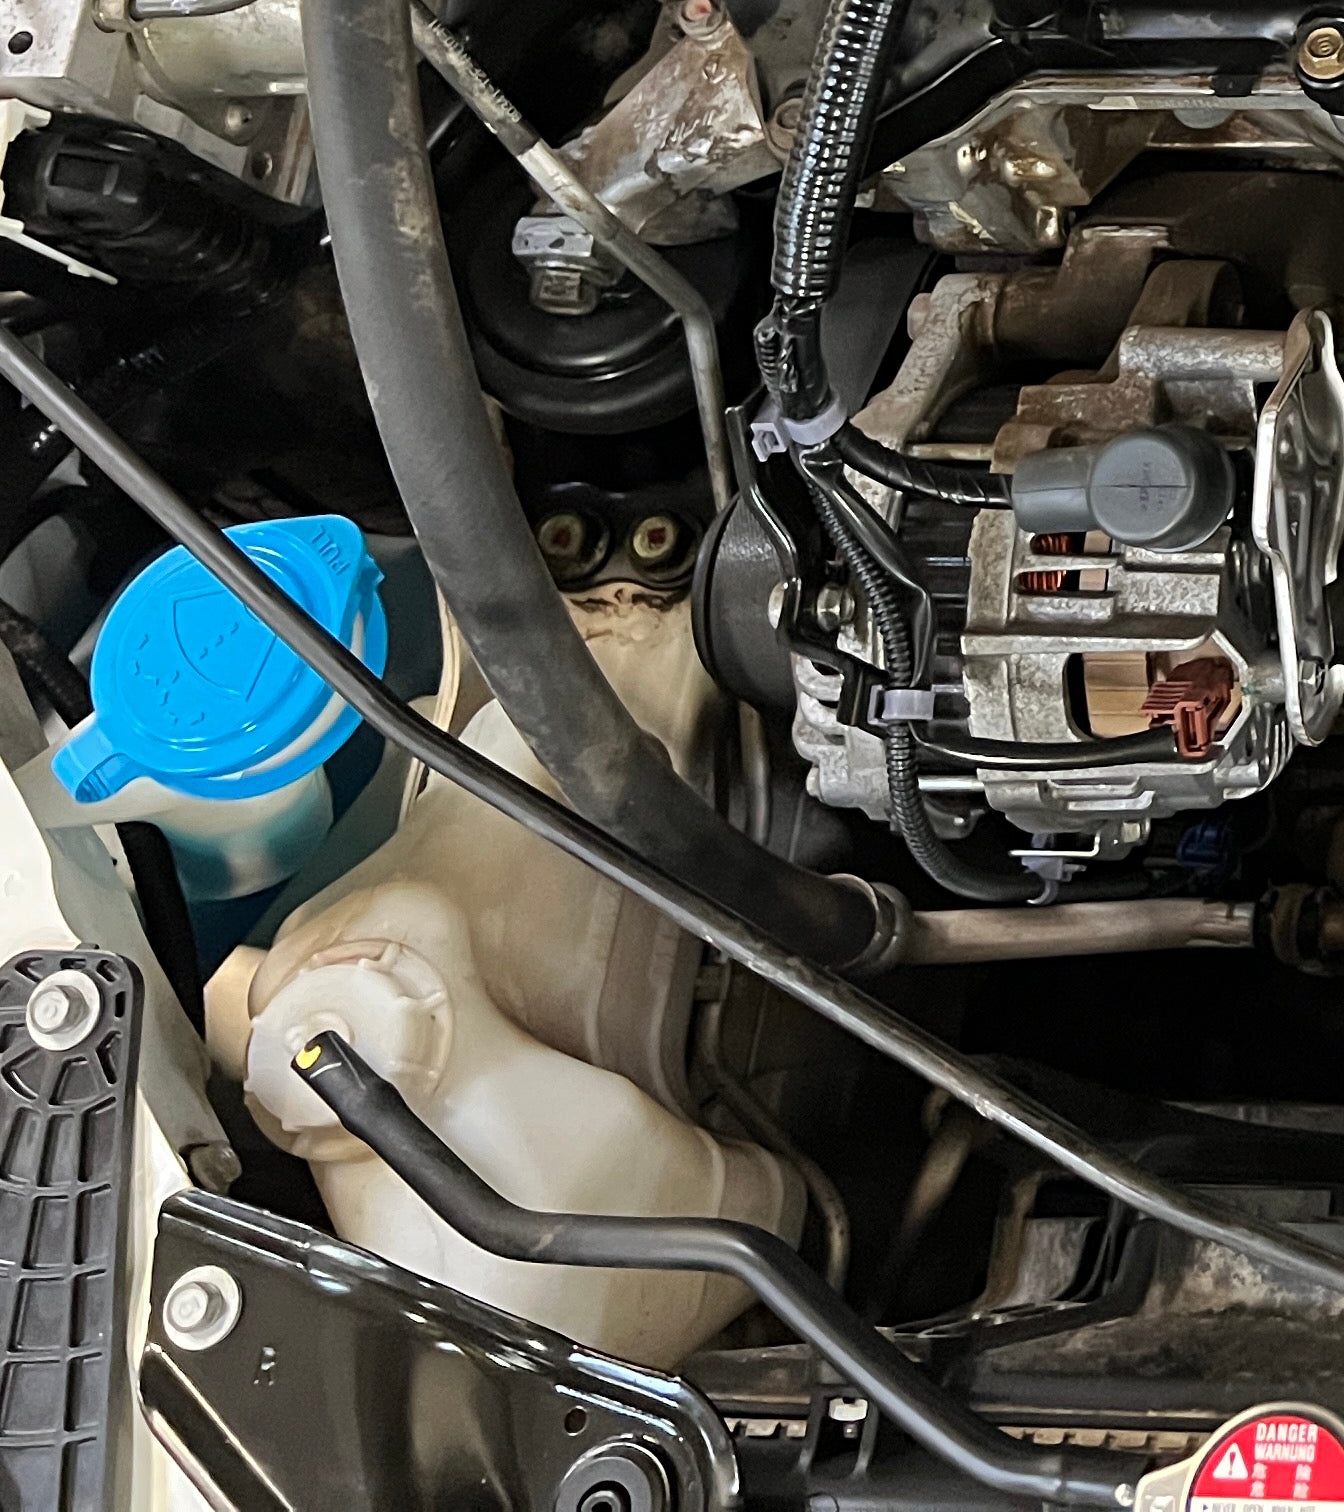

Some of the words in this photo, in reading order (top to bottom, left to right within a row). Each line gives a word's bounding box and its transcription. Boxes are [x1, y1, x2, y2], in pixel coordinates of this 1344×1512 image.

[311, 524, 352, 577] PULL
[1255, 1423, 1319, 1444] DANGER
[1254, 1443, 1316, 1463] WARNUNG
